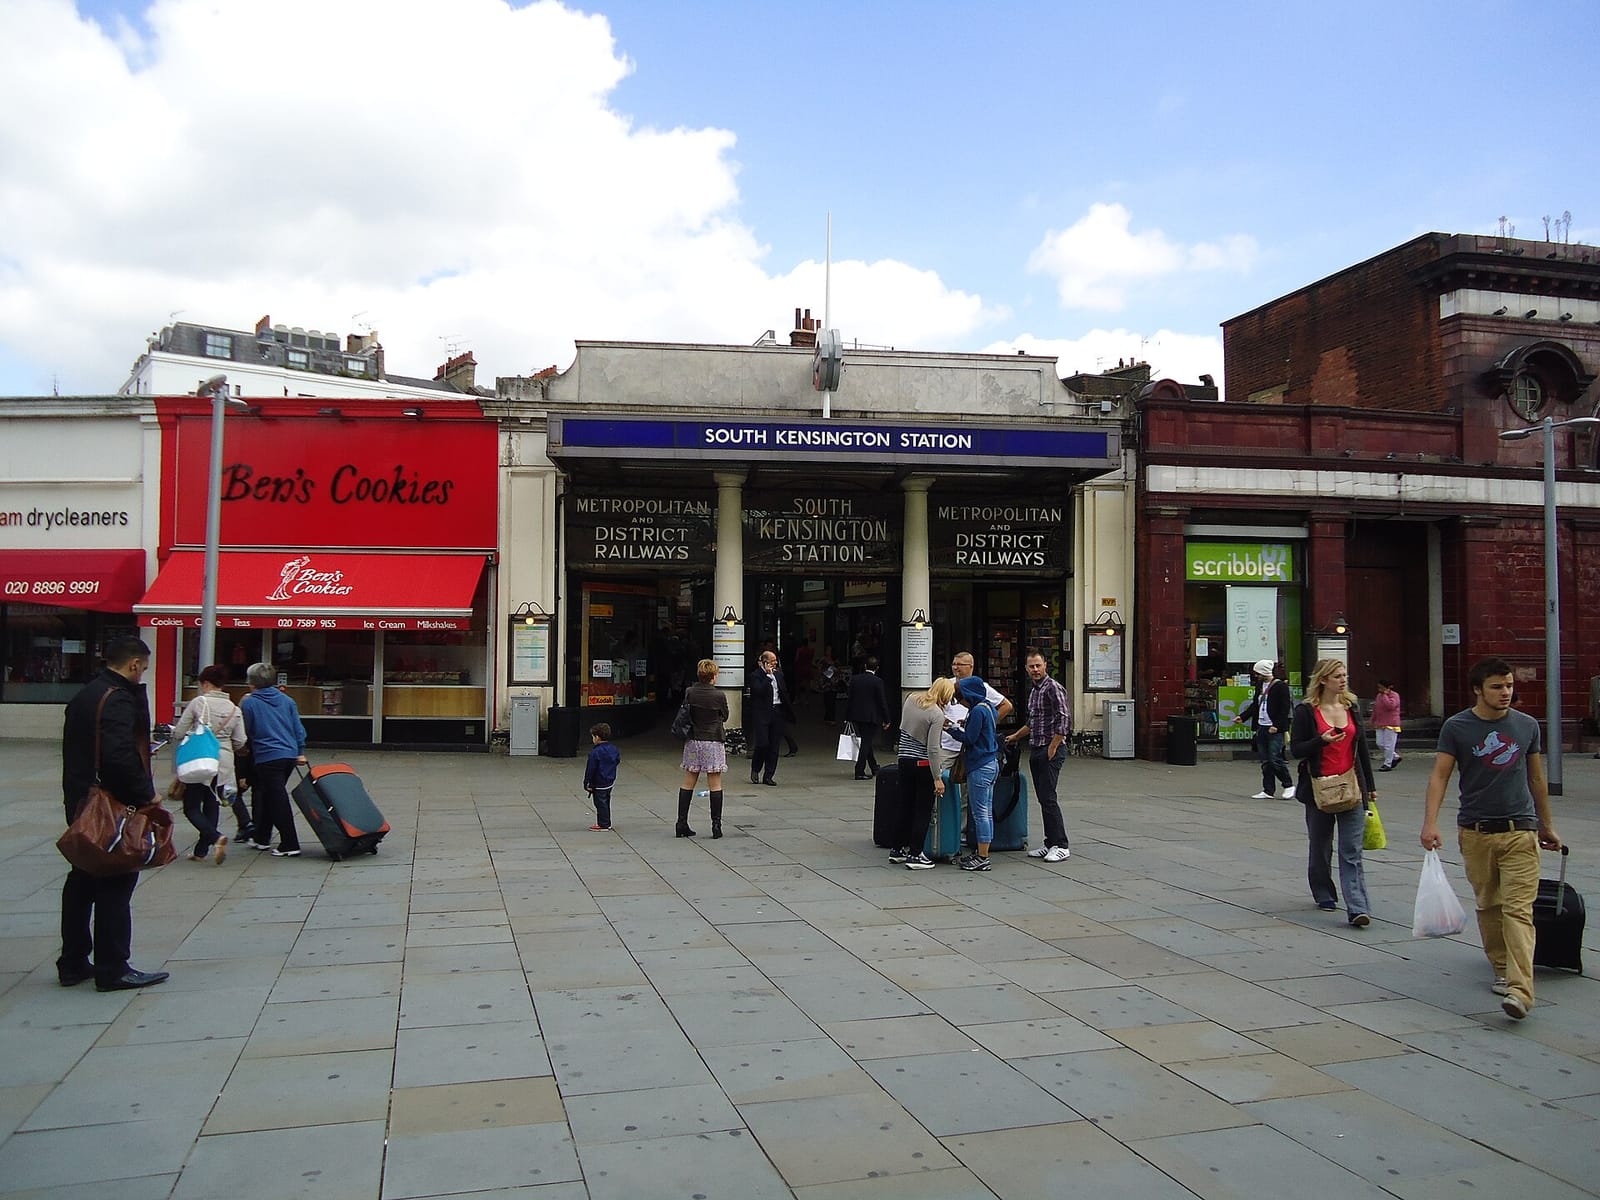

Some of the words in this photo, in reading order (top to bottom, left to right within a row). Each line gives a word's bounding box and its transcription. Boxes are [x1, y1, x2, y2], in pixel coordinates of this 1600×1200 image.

[705, 428, 767, 444] SOUTH
[775, 430, 890, 447] KENSINGTON
[900, 433, 972, 449] STATION
[221, 463, 316, 504] Ben's
[331, 464, 454, 505] Cookies
[576, 498, 708, 515] METROPOLITAN
[793, 498, 852, 515] SOUTH
[938, 506, 1062, 522] METROPOLITAN
[27, 507, 128, 531] drycleaners
[631, 516, 654, 524] AND
[595, 526, 689, 542] DISTRICT
[760, 518, 887, 541] KENSINGTON
[956, 533, 1045, 549] DISTRICT
[595, 544, 689, 560] RAILWAYS
[782, 544, 865, 562] STATION
[956, 550, 1045, 566] RAILWAYS
[1192, 552, 1286, 577] scribbler
[296, 568, 344, 582] Ben's
[4, 581, 29, 594] 020
[32, 581, 66, 594] 8896
[69, 580, 100, 594] 9991
[293, 580, 353, 596] Cookies
[150, 617, 184, 626] Cookies
[232, 618, 251, 627] Teas
[278, 619, 293, 627] 020
[296, 619, 316, 628] 7589
[320, 619, 337, 628] 9155
[363, 620, 375, 629] Ice
[378, 620, 406, 629] Cream
[417, 620, 457, 629] Milkshakes
